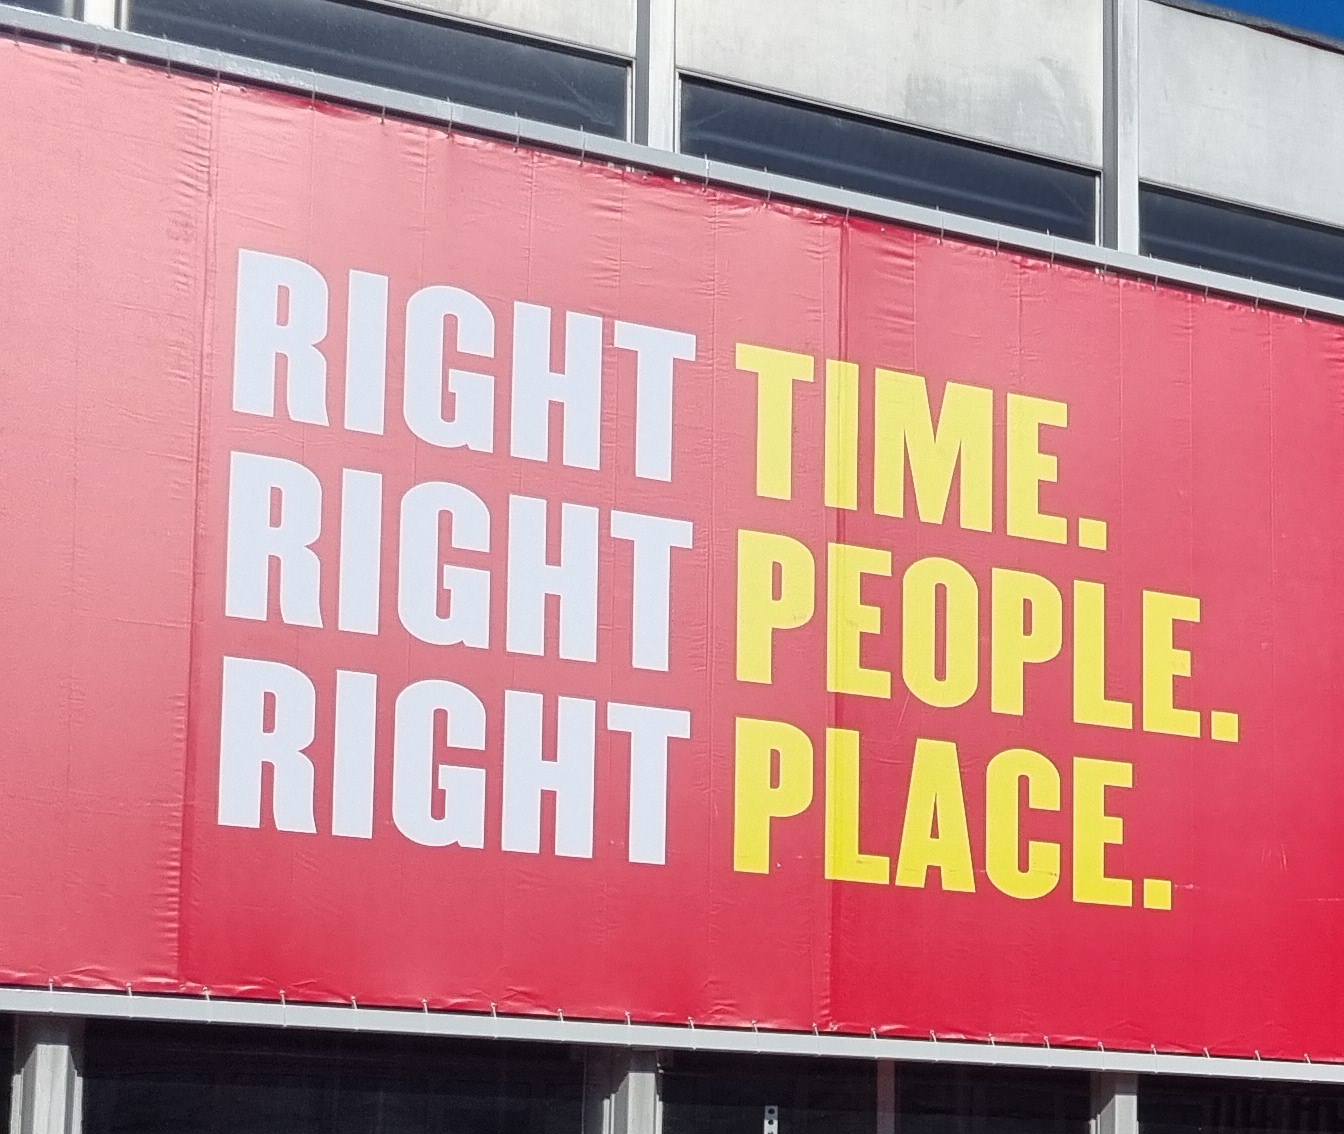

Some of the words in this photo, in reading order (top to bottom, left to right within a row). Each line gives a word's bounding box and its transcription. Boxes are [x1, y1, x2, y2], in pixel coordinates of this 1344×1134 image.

[232, 248, 697, 483] RIGHT
[734, 343, 1108, 552] TIME.
[224, 450, 694, 673] RIGHT
[735, 528, 1240, 743] PEOPLE.
[217, 654, 692, 867] RIGHT
[733, 717, 1172, 911] PLACE.
